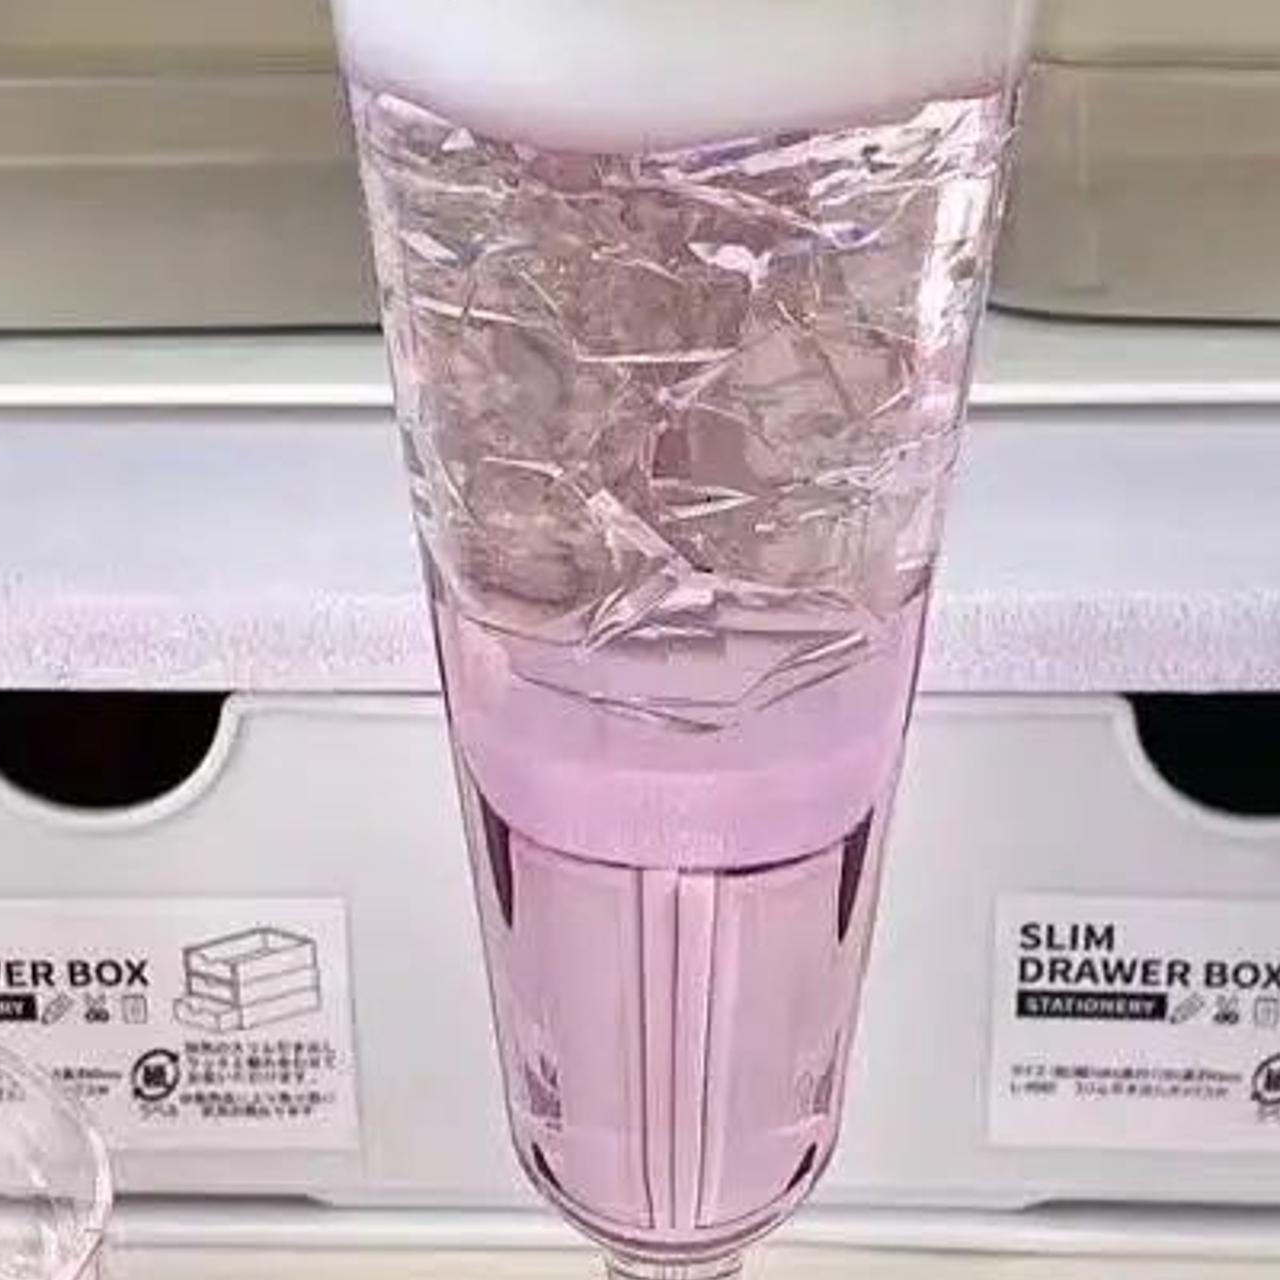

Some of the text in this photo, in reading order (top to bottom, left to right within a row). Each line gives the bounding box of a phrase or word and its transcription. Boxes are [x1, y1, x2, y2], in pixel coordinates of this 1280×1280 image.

[1019, 923, 1115, 951] SLIM
[68, 960, 149, 987] BOX
[1018, 957, 1192, 987] DRAWER
